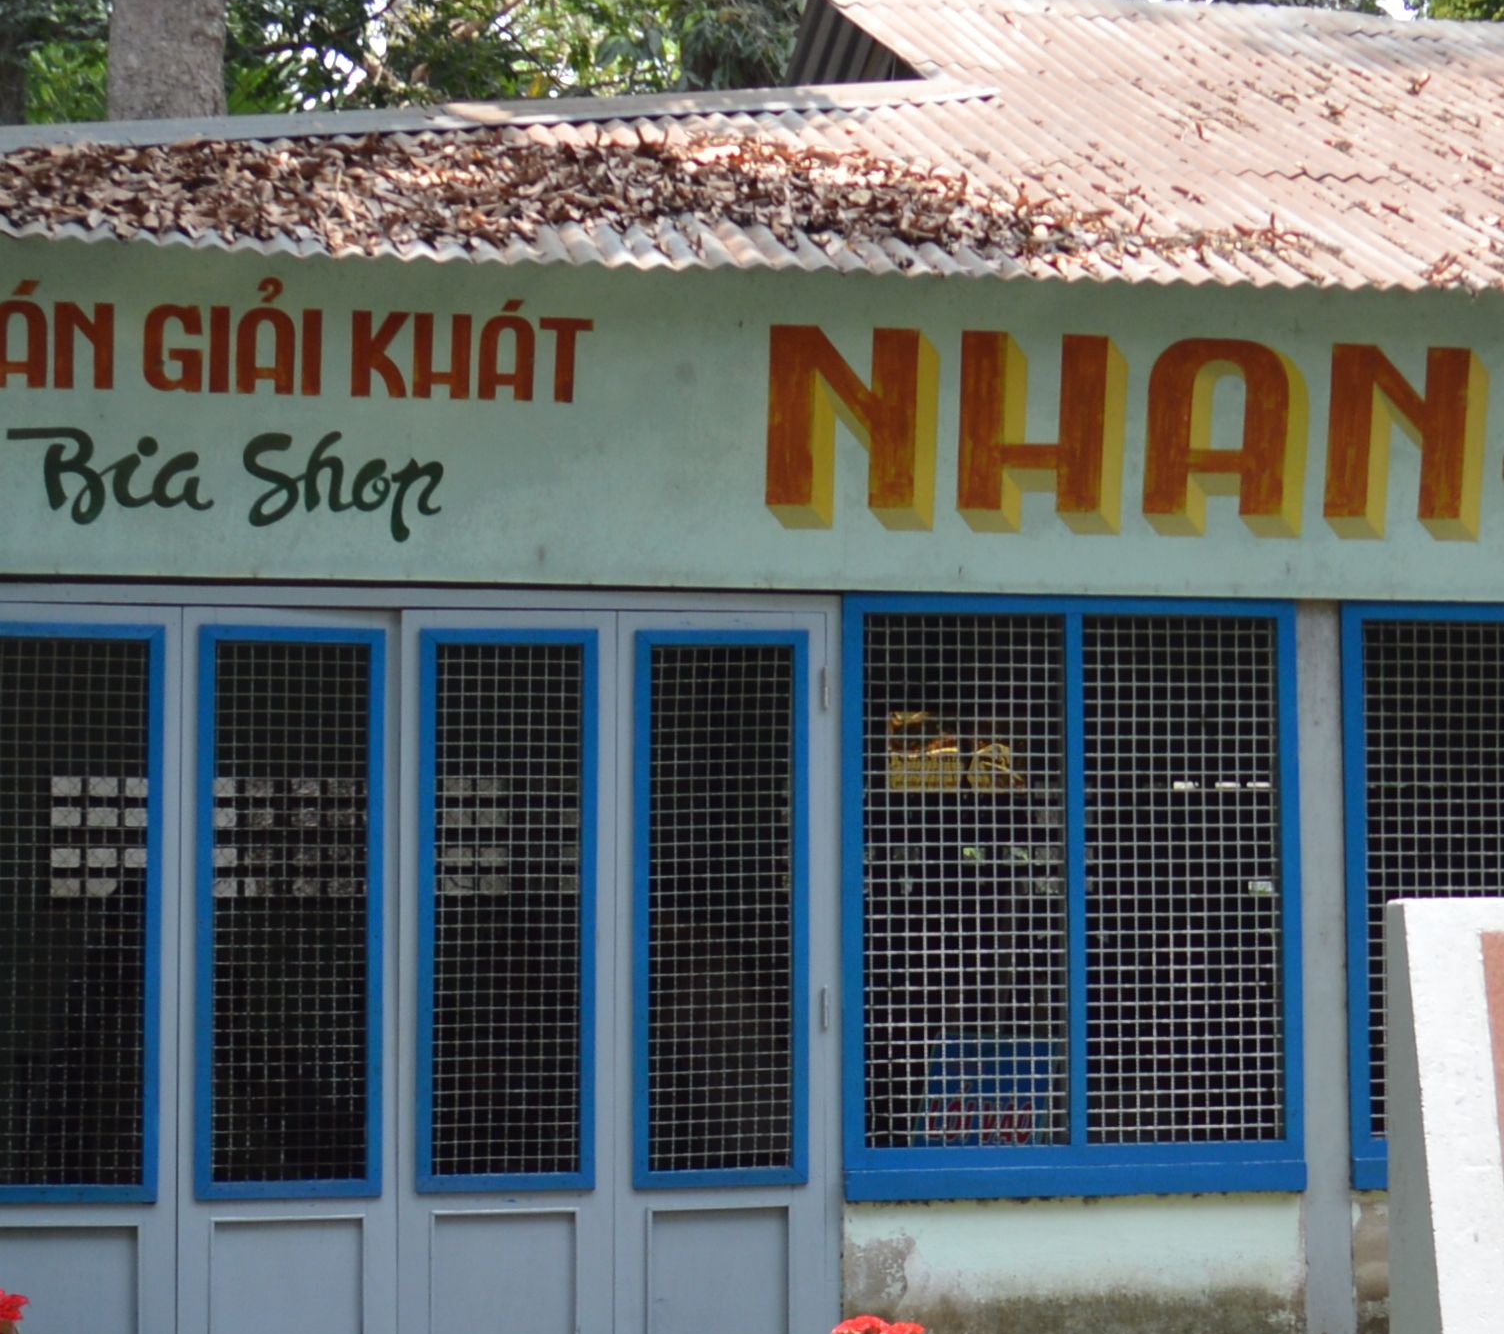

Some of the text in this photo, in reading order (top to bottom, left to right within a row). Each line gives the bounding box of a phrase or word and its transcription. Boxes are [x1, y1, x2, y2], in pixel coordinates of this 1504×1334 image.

[142, 277, 322, 398] GIẢI
[351, 299, 595, 403] KHÁT
[6, 426, 445, 543] Bia Shop
